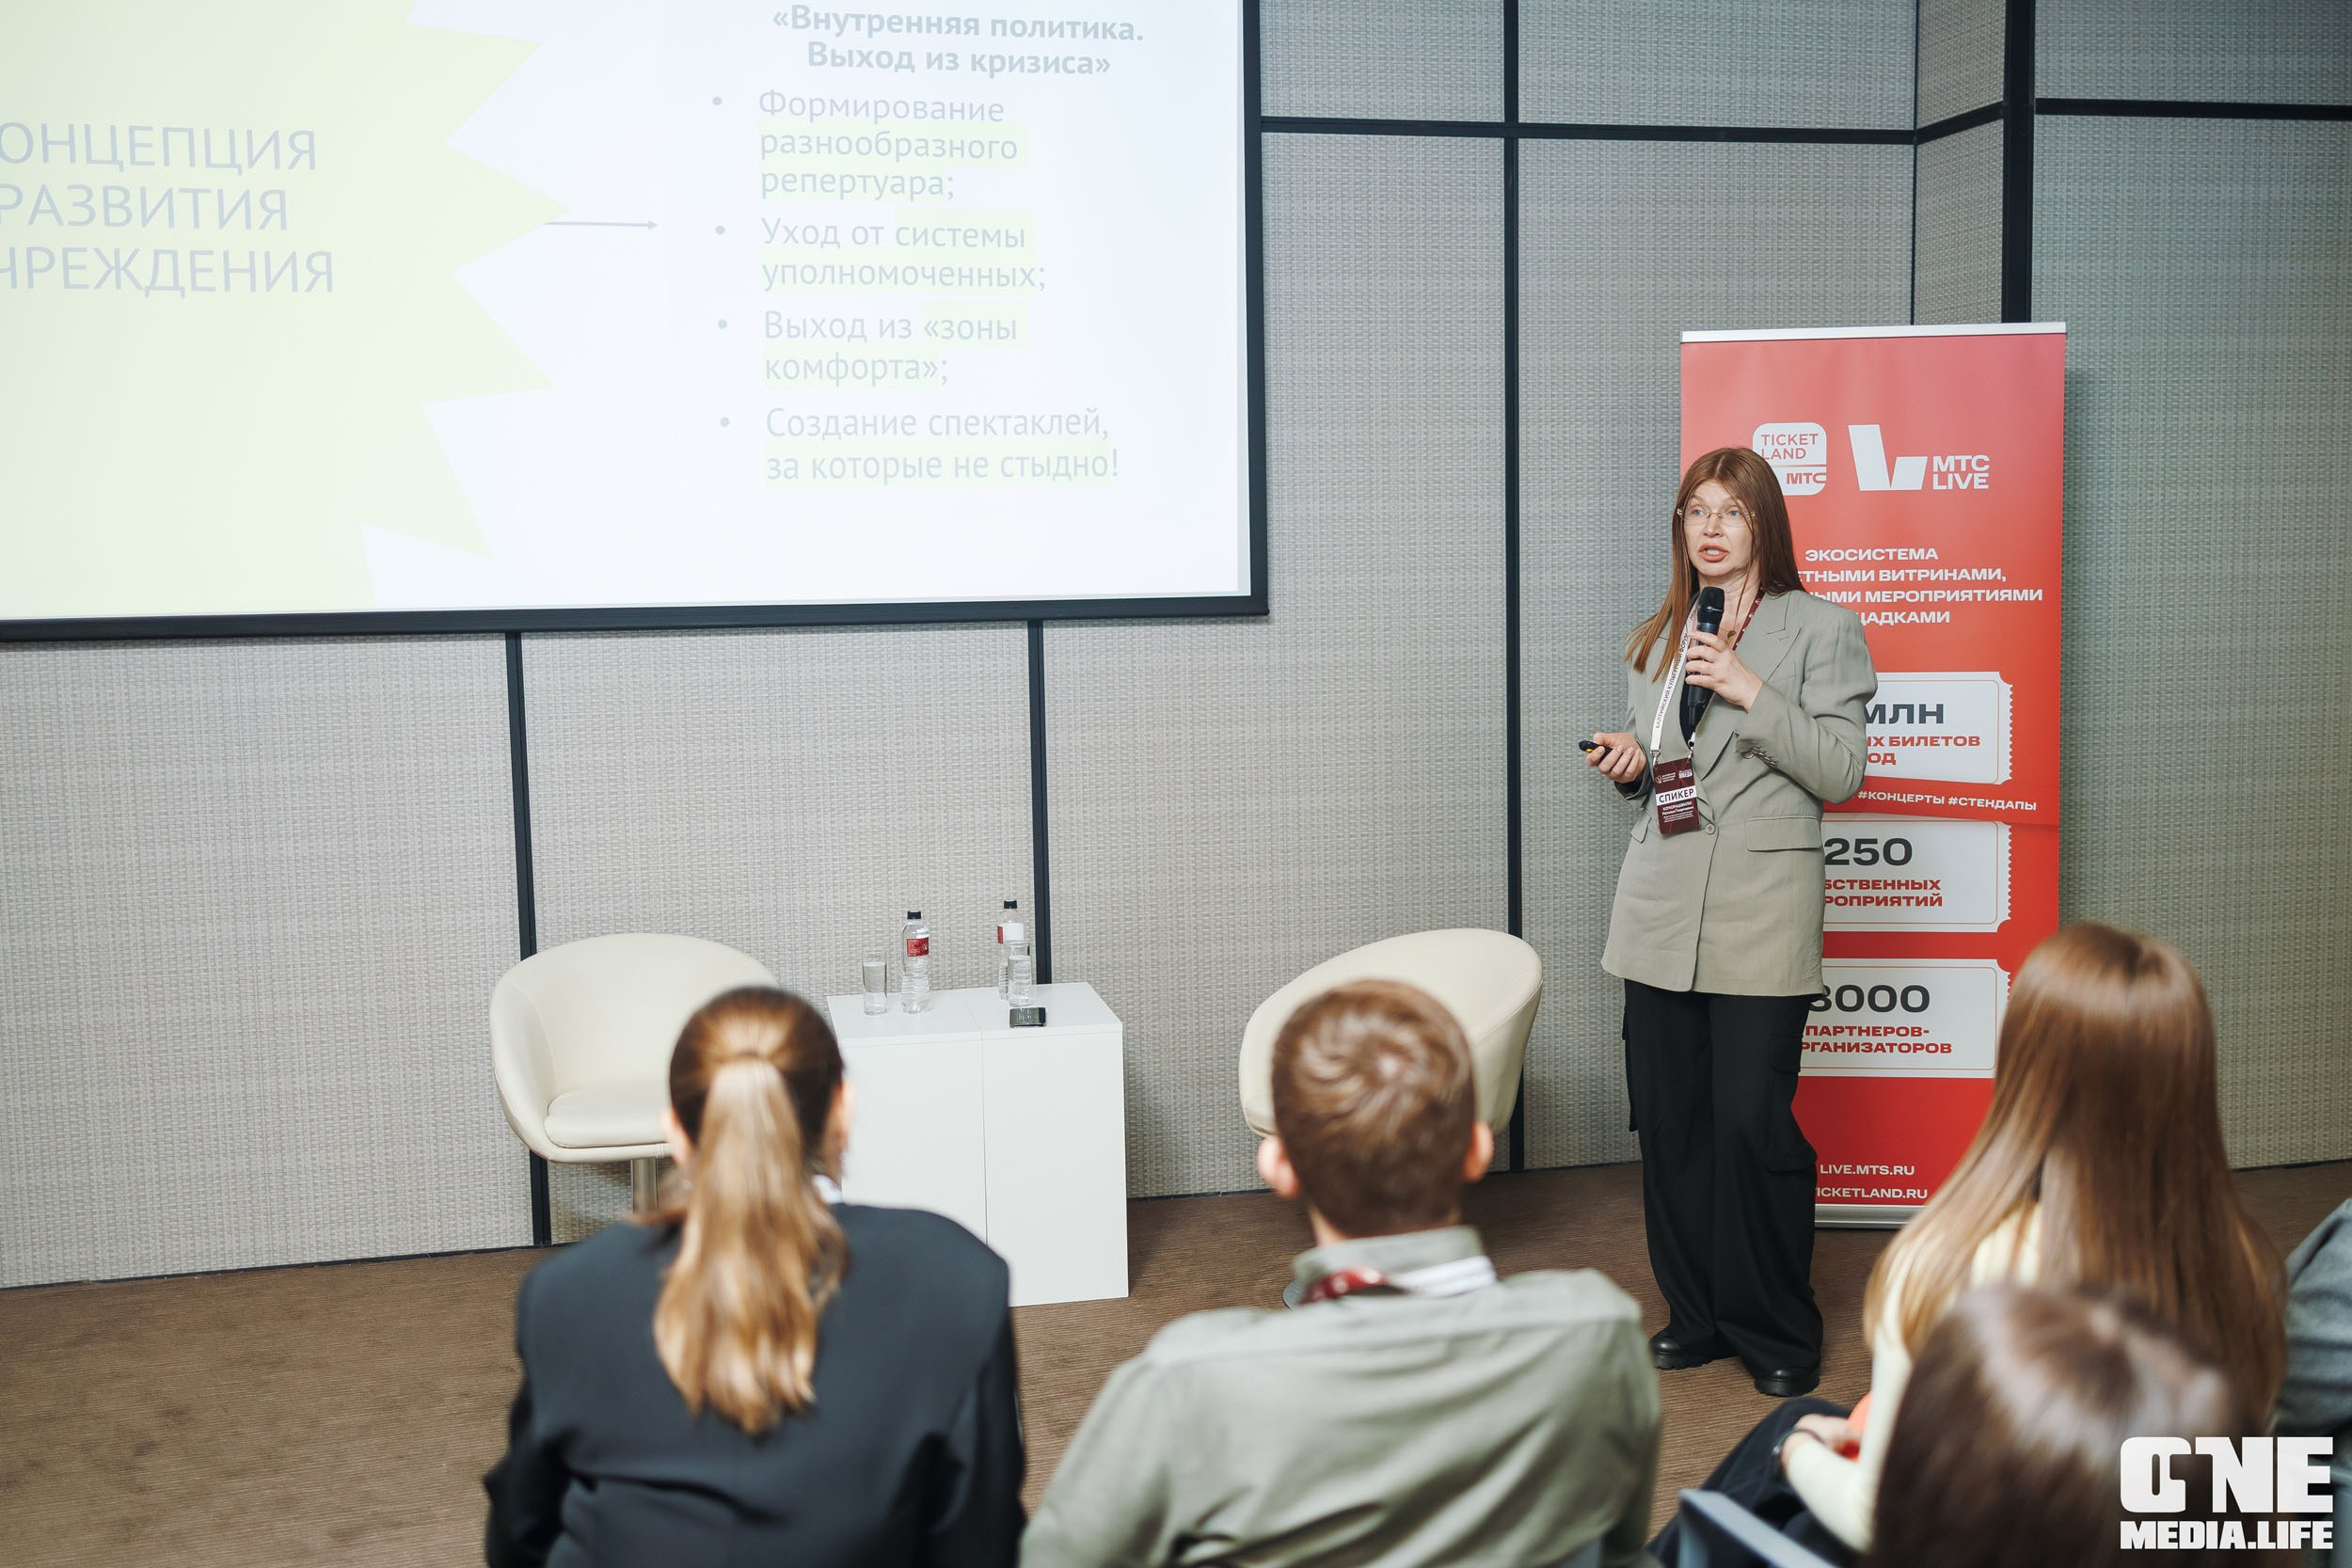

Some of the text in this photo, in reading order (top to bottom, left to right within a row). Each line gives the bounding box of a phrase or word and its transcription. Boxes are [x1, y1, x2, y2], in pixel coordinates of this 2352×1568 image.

[772, 4, 1144, 42] «Внутренняя политика.
[806, 40, 1112, 79] Выход из кризиса»
[757, 88, 1005, 124] Формирование
[0, 120, 317, 176] ОНЦЕПЦИЯ
[759, 129, 1019, 164] разнообразного
[760, 167, 955, 199] репертуара;
[759, 217, 1025, 249] Уход от системы
[760, 261, 1046, 292] уполномоченных;
[764, 309, 1017, 342] Выход из «зоны
[765, 351, 948, 387] комфорта»;
[766, 407, 1109, 440] Создание спектаклей,
[1761, 434, 1819, 446] TICKET
[1761, 448, 1806, 460] LAND
[1932, 455, 1990, 471] МТС
[767, 449, 1120, 485] за которые не стыдно!
[1786, 472, 1827, 484] МТС
[1932, 473, 1989, 490] LIVE
[1804, 548, 1938, 562] ЭКОСИСТЕМА
[1798, 568, 2007, 582] ТНЫМИ ВИТРИНАМИ,
[1865, 589, 2043, 603] МЕРОПРИЯТИЯМИ
[1865, 704, 1944, 724] МЛН
[1888, 736, 1980, 747] БИЛЕТОВ
[1659, 788, 1693, 803] СПИКЕР
[1858, 791, 2037, 811] #КОНЦЕРТЫ #СТЕНДАПЫ
[1824, 837, 1913, 866] 250
[1805, 1025, 1930, 1037] ПАРТНЕРОВ-
[1820, 1164, 1915, 1176] LIVE.MTS.RU
[1815, 1187, 1928, 1199] ICKETLAND.RU
